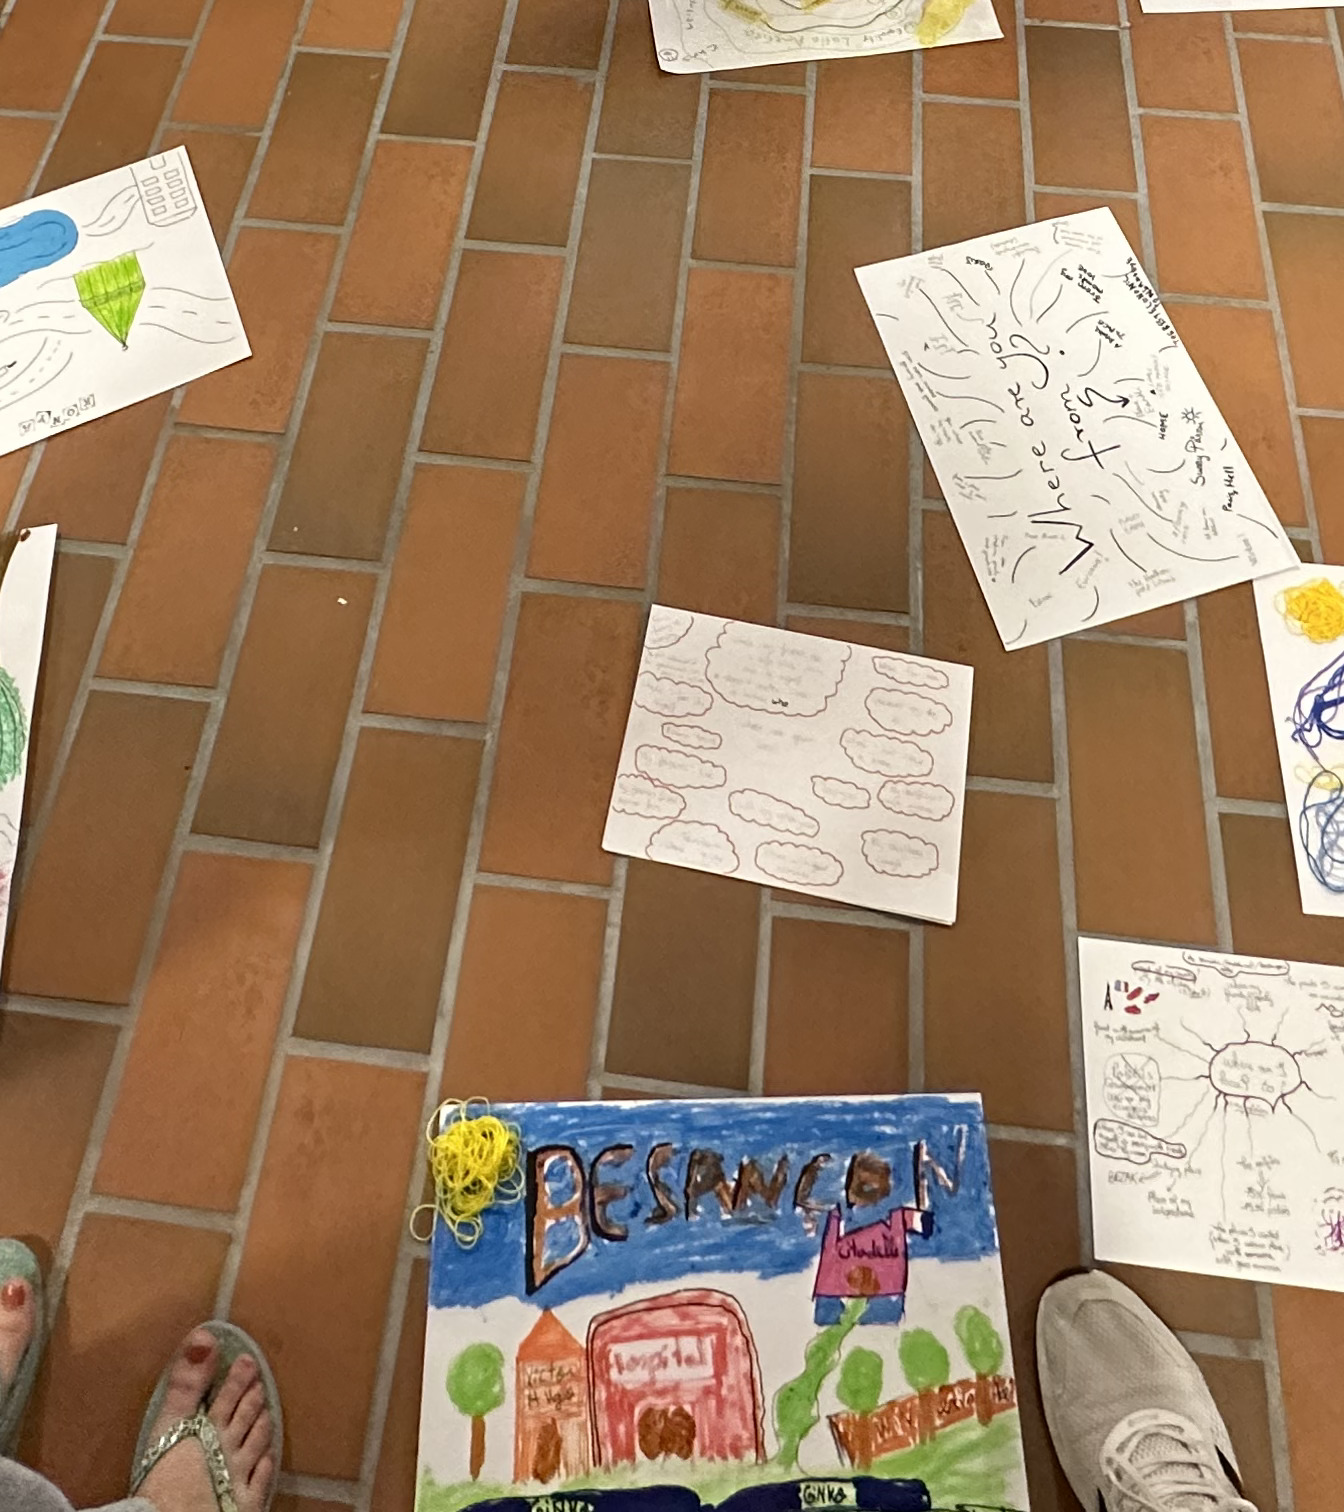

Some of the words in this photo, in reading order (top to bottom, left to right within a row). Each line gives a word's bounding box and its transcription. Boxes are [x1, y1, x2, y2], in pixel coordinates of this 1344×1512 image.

[986, 312, 1050, 390] you
[1008, 382, 1034, 426] are
[1059, 383, 1121, 470] from
[1150, 412, 1168, 440] HOME
[1028, 441, 1095, 576] Where
